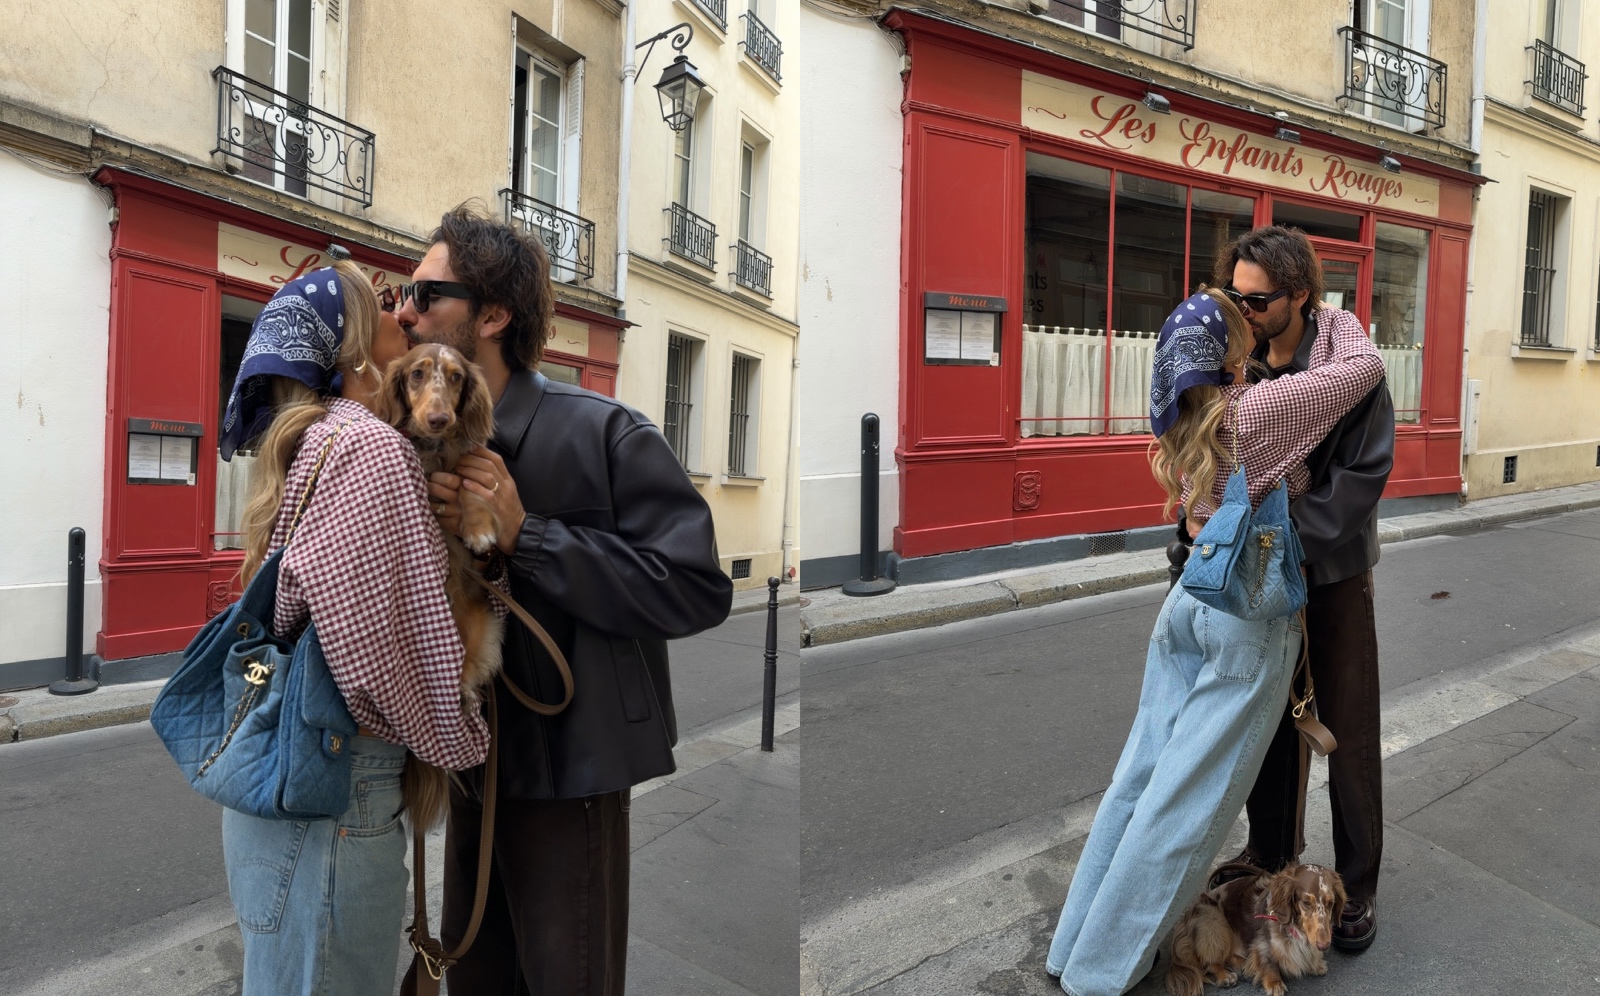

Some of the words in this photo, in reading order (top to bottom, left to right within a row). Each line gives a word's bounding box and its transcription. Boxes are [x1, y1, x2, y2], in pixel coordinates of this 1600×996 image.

[1079, 95, 1156, 149] Les
[1179, 117, 1303, 177] Enfants
[1309, 155, 1403, 205] Rouges
